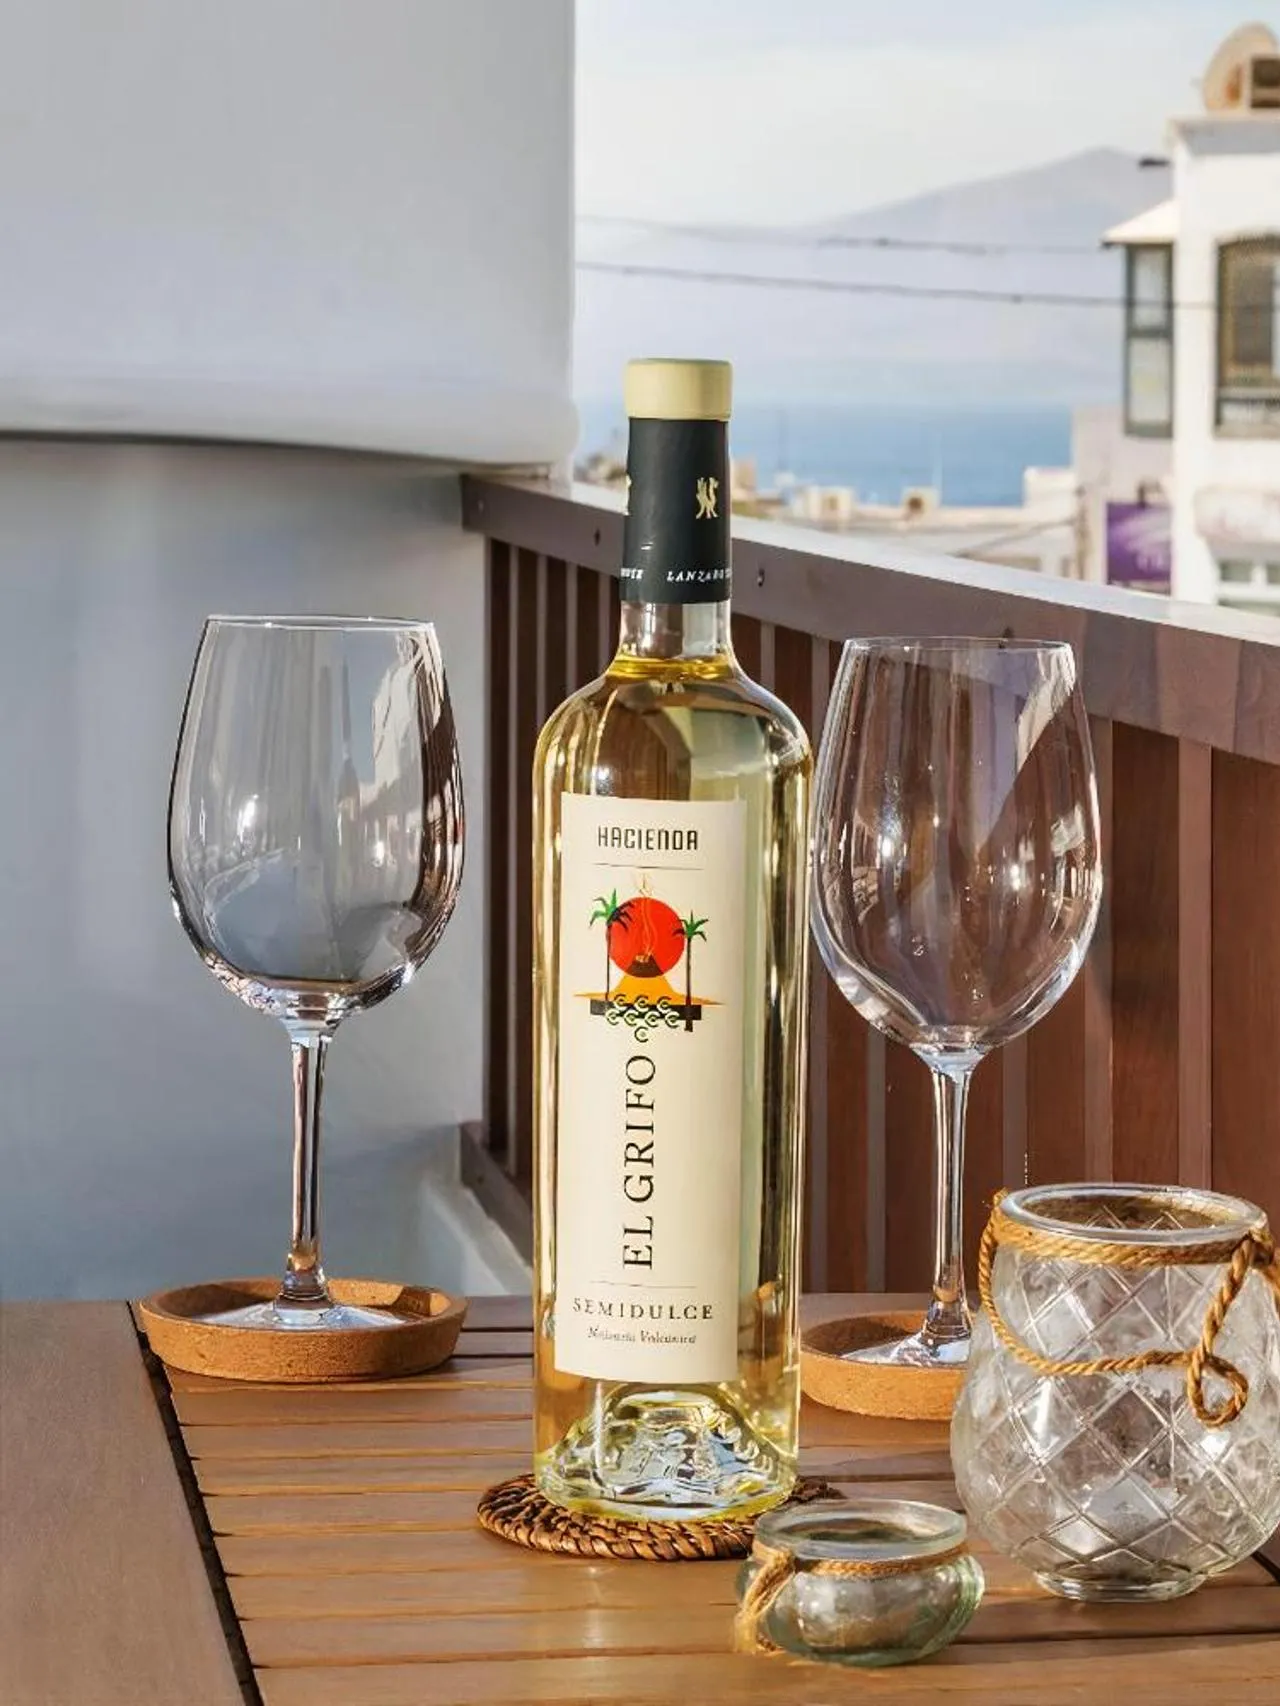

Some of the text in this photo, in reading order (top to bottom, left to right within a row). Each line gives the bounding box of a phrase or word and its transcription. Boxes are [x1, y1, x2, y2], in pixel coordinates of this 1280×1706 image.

[597, 825, 698, 850] HACIENDA
[623, 1055, 656, 1270] EL GRIFO
[572, 1297, 714, 1320] SEMIDULCE
